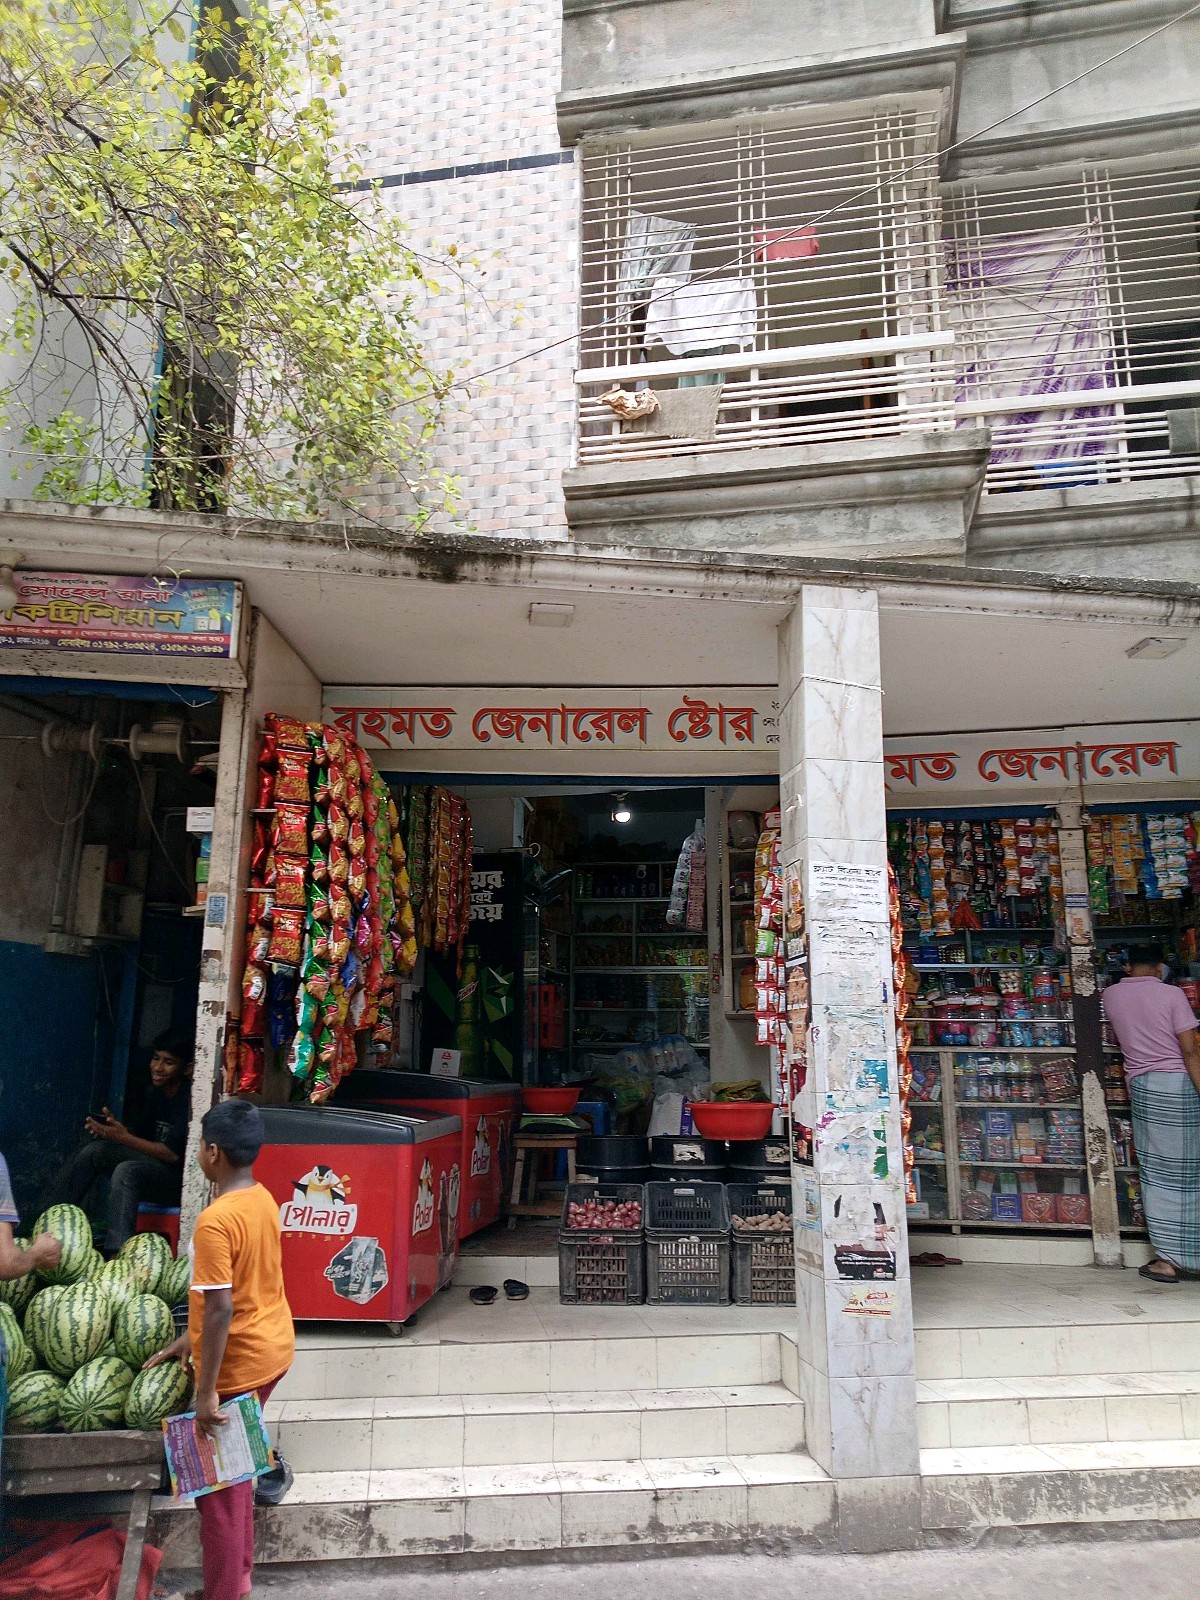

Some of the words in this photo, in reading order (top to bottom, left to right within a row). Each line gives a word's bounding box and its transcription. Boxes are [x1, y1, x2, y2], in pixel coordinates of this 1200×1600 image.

[19, 585, 110, 600] সোহেল
[114, 588, 173, 603] রানা
[330, 706, 457, 748] রহমত
[472, 702, 652, 744] জেনারেল
[667, 694, 758, 743] ষ্টোর
[884, 752, 960, 793] মত
[977, 741, 1182, 783] জেনারেল
[283, 1204, 351, 1233] পোলার
[414, 1199, 433, 1231] Polar
